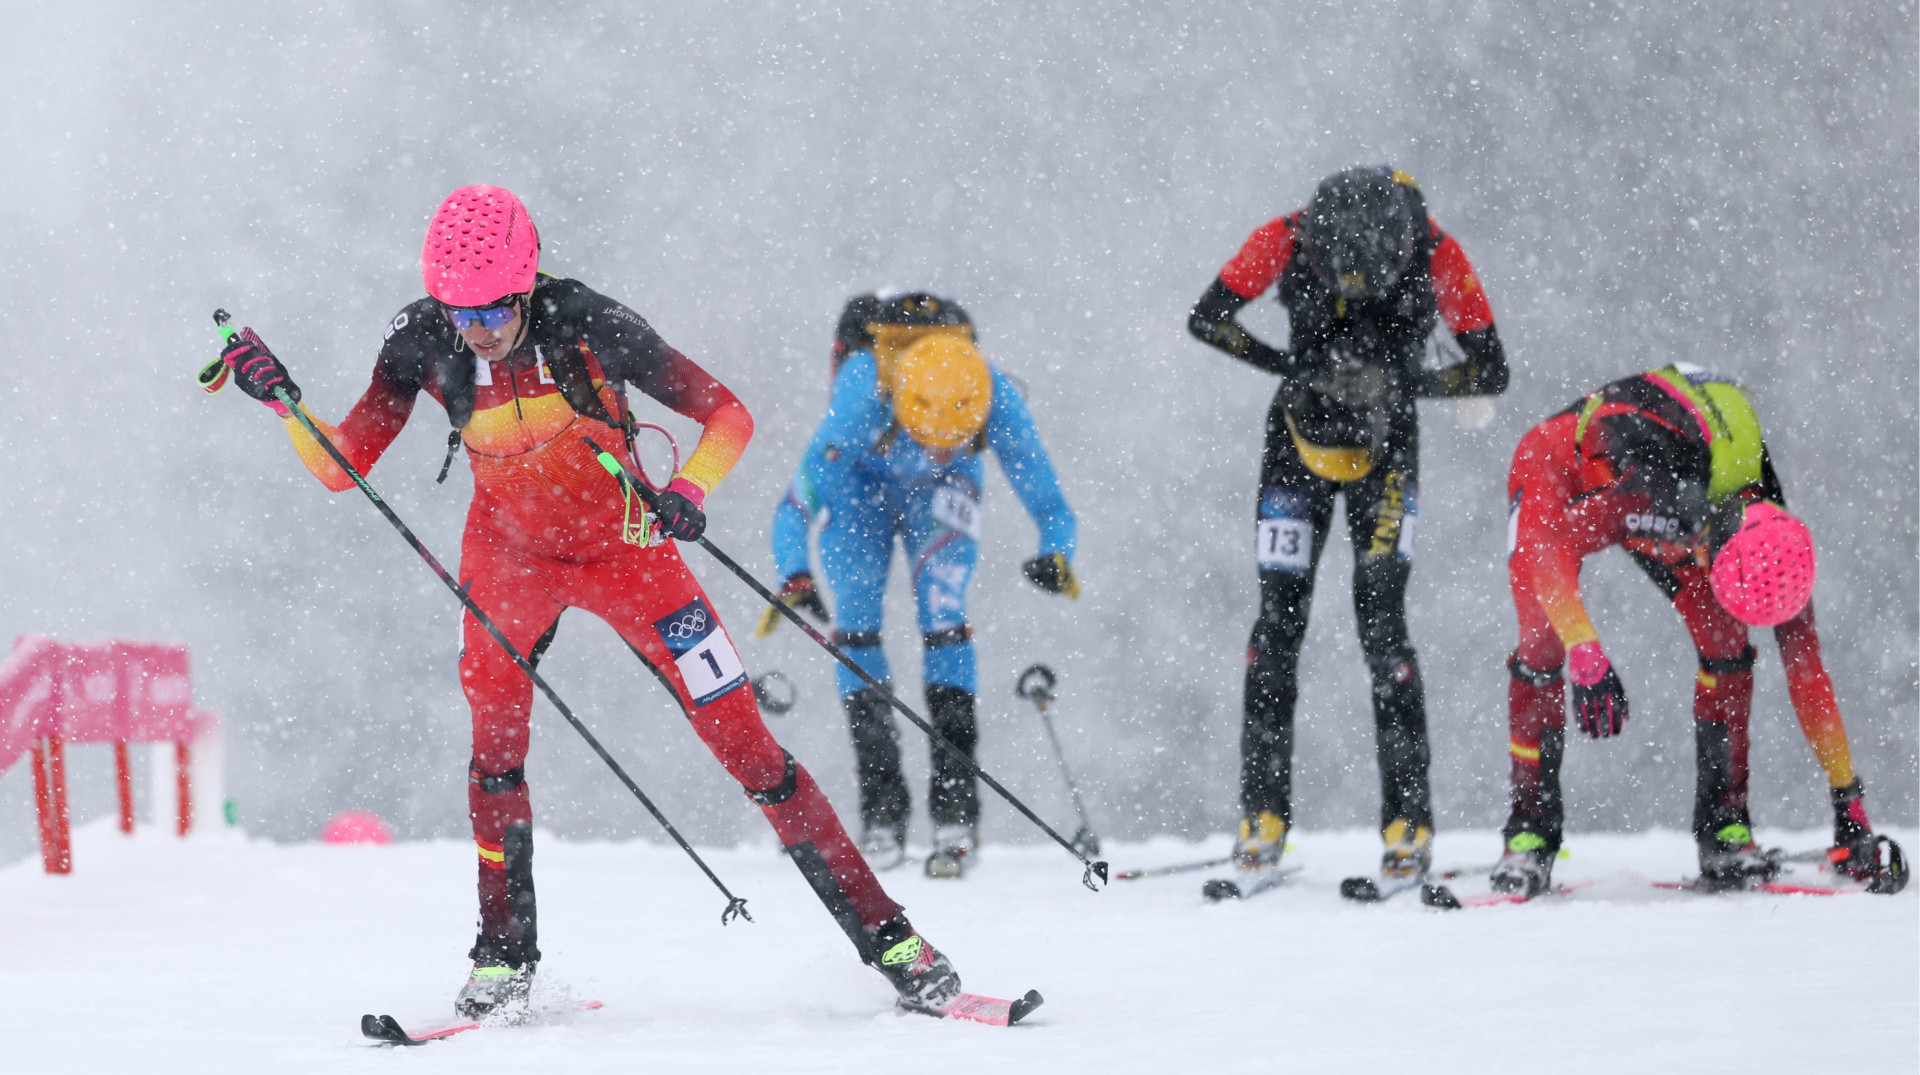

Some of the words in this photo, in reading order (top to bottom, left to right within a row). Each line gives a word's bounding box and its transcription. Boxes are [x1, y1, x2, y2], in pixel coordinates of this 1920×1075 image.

[348, 468, 381, 501] DYNAFIT
[1367, 472, 1405, 558] CHINA
[1268, 527, 1299, 555] 13
[699, 649, 724, 679] 1
